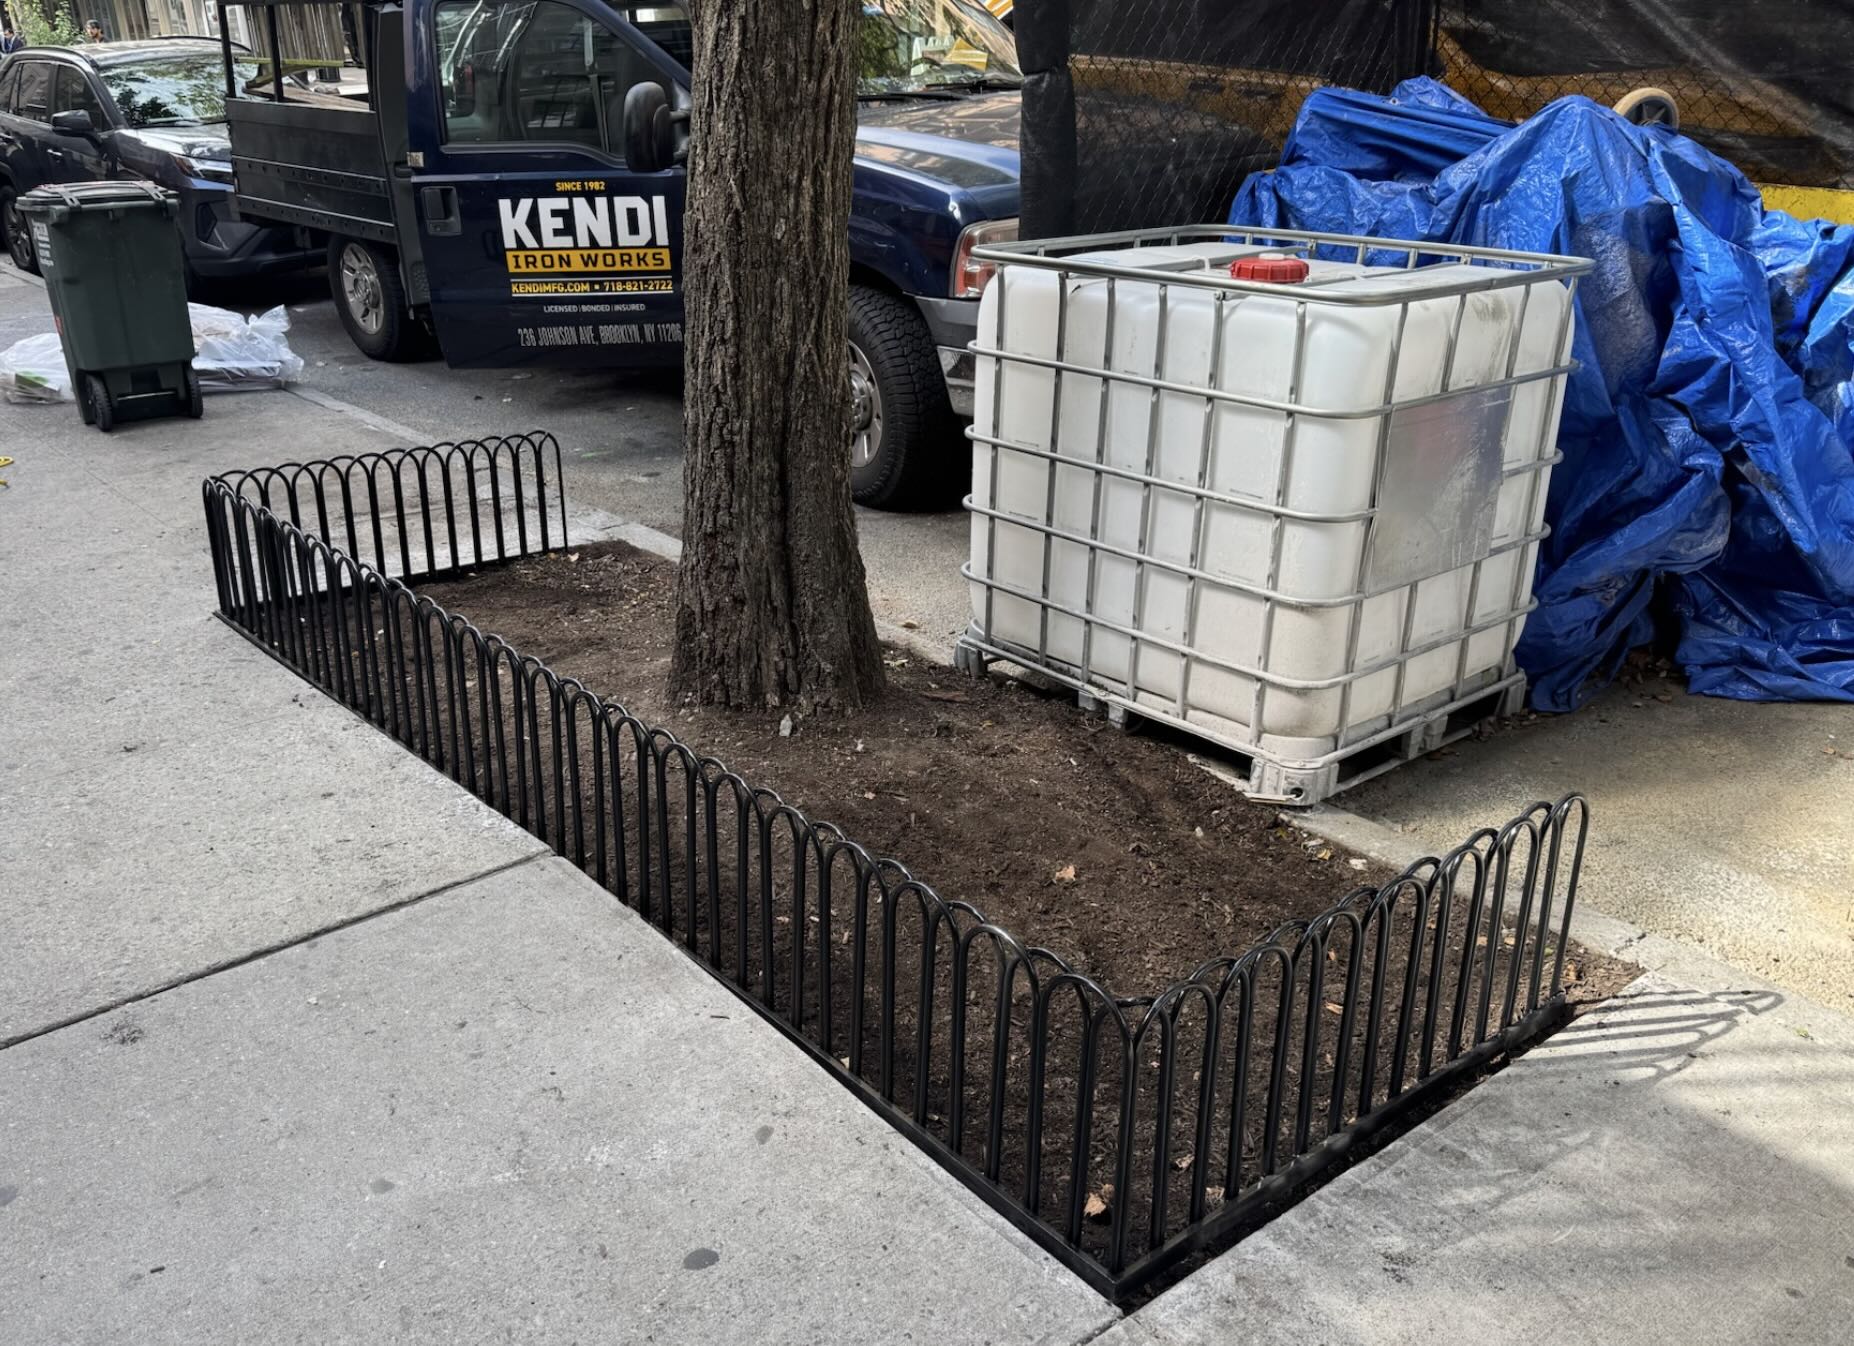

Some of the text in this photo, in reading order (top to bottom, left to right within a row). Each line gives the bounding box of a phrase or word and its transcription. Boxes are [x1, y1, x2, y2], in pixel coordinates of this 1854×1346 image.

[556, 181, 605, 192] SINCE 1982
[498, 195, 669, 249] KENDI
[513, 252, 665, 269] IRON WORKS
[512, 280, 673, 293] KENDIMFG.COM 718-821-2722
[544, 303, 645, 313] LICENSED BONDED INSURED
[517, 328, 537, 347] 236
[538, 326, 578, 346] JOHNSON
[644, 323, 656, 343] NY
